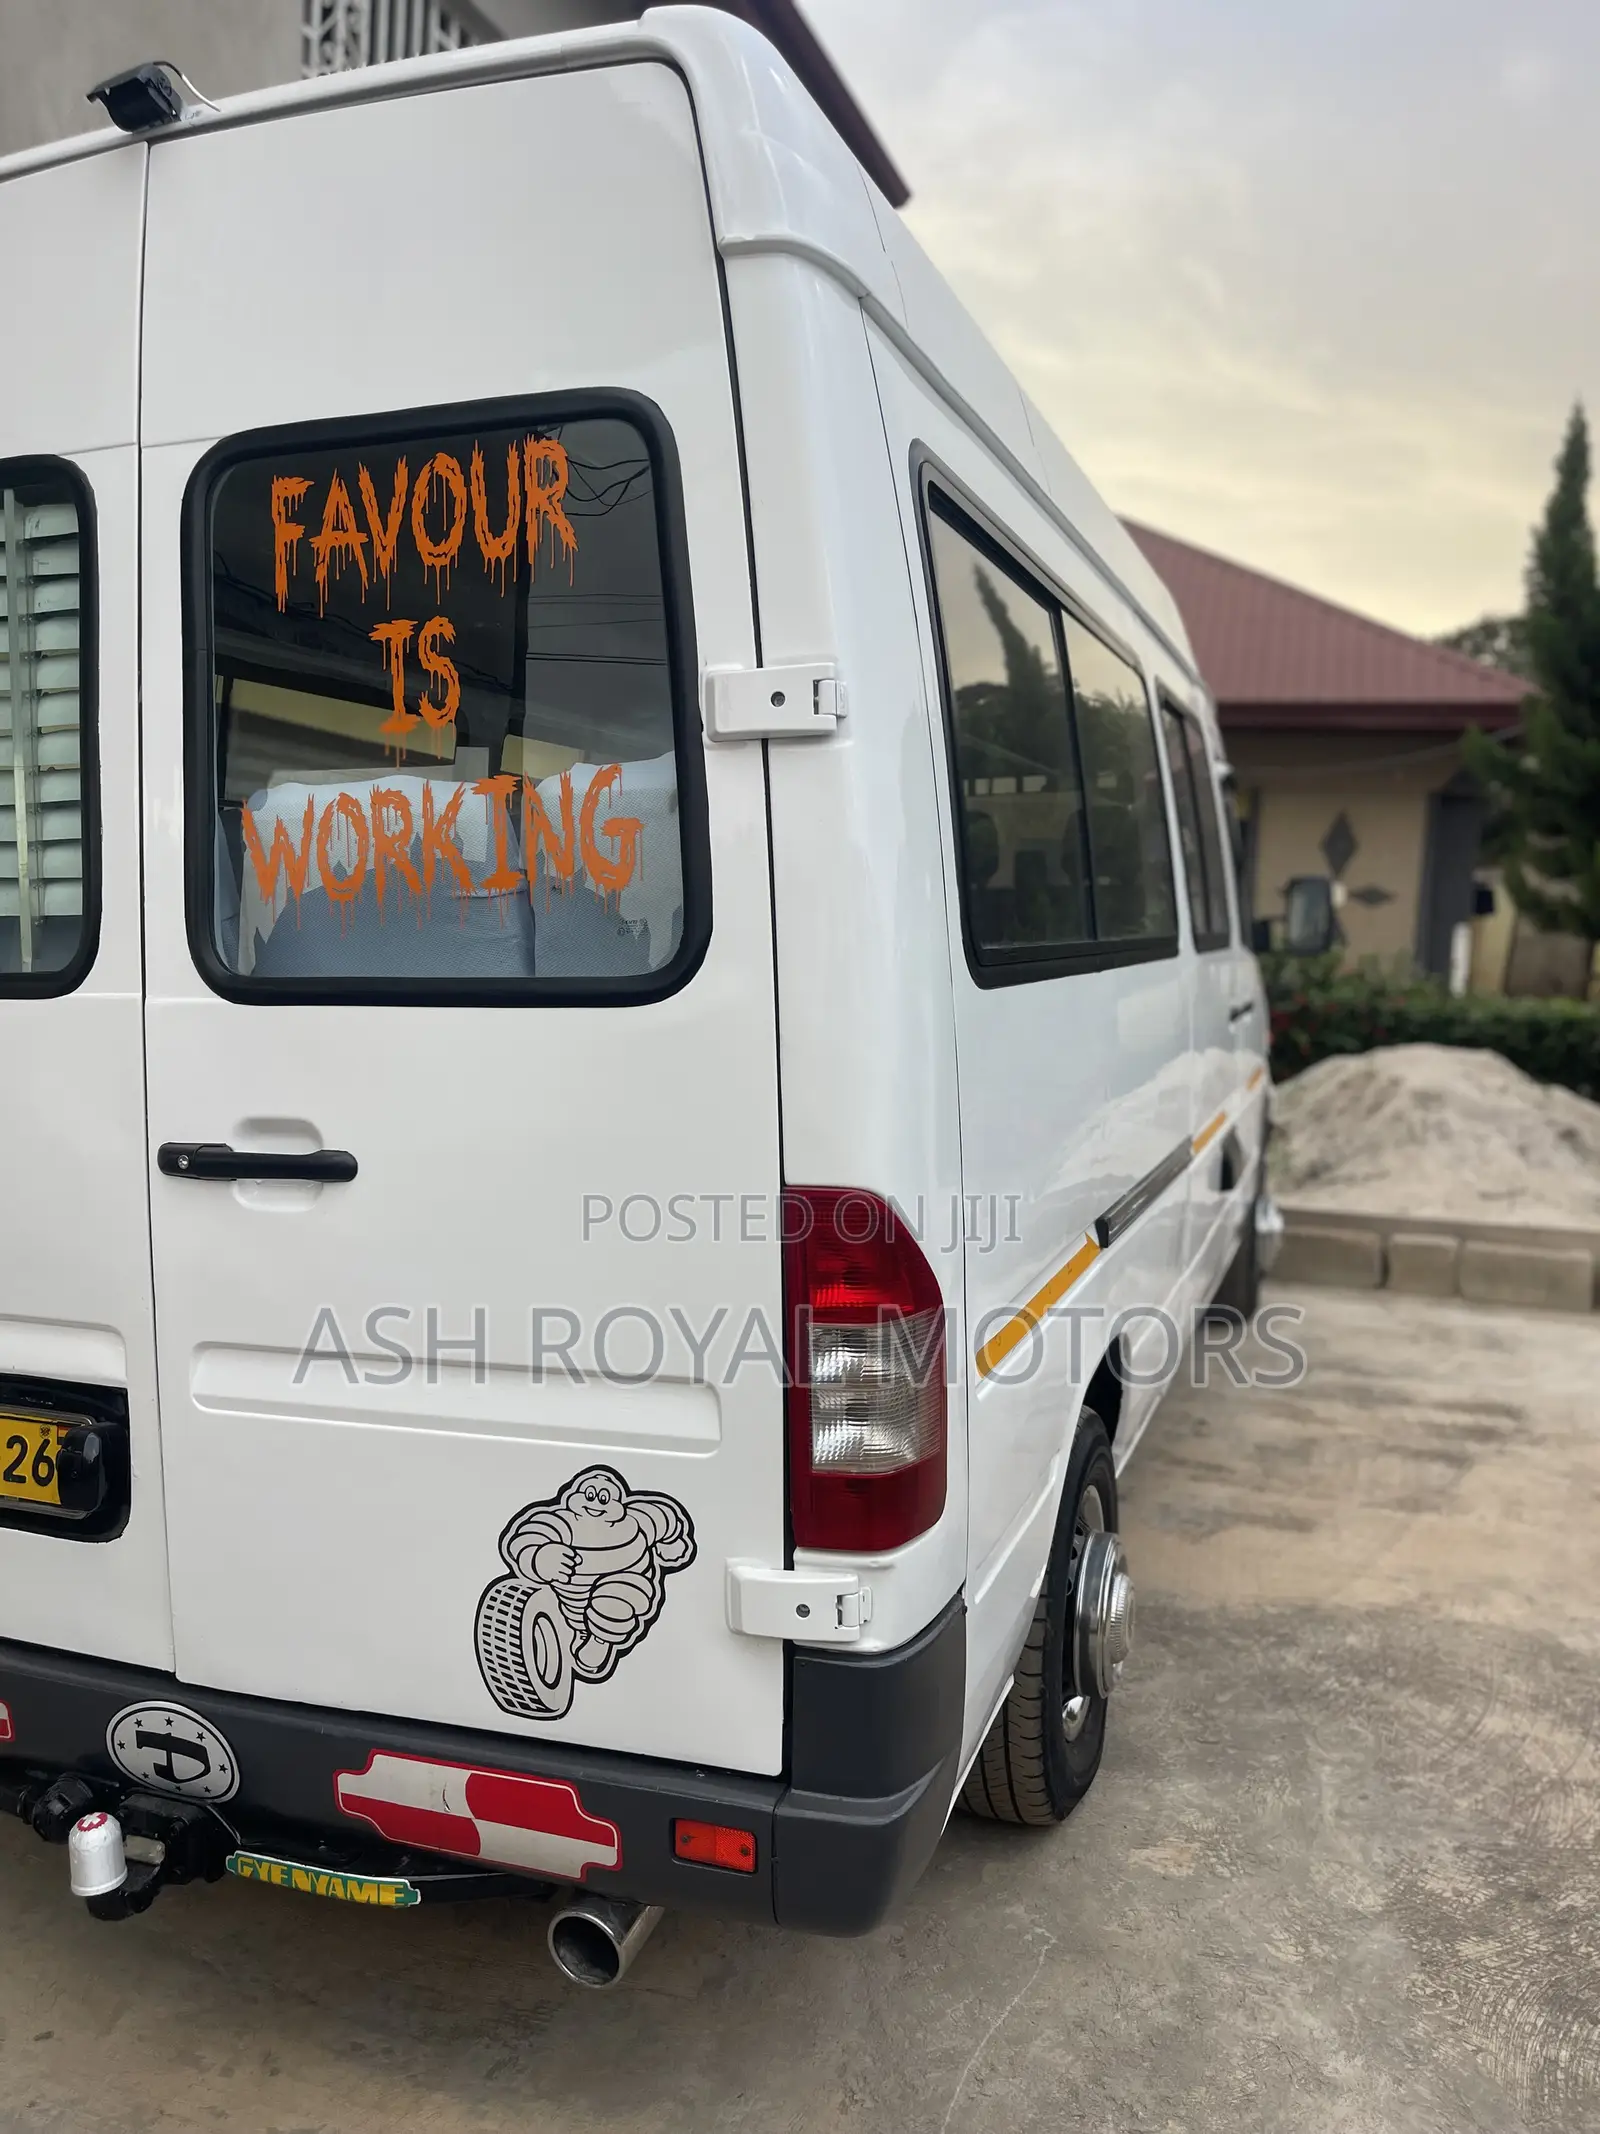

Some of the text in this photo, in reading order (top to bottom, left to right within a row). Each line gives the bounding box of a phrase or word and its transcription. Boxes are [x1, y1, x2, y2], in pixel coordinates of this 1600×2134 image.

[271, 433, 578, 617] FAVOUR
[368, 615, 461, 768] IS
[241, 763, 644, 938] WORKING
[3, 1434, 55, 1487] 26
[237, 1856, 405, 1906] GYE NYAME
